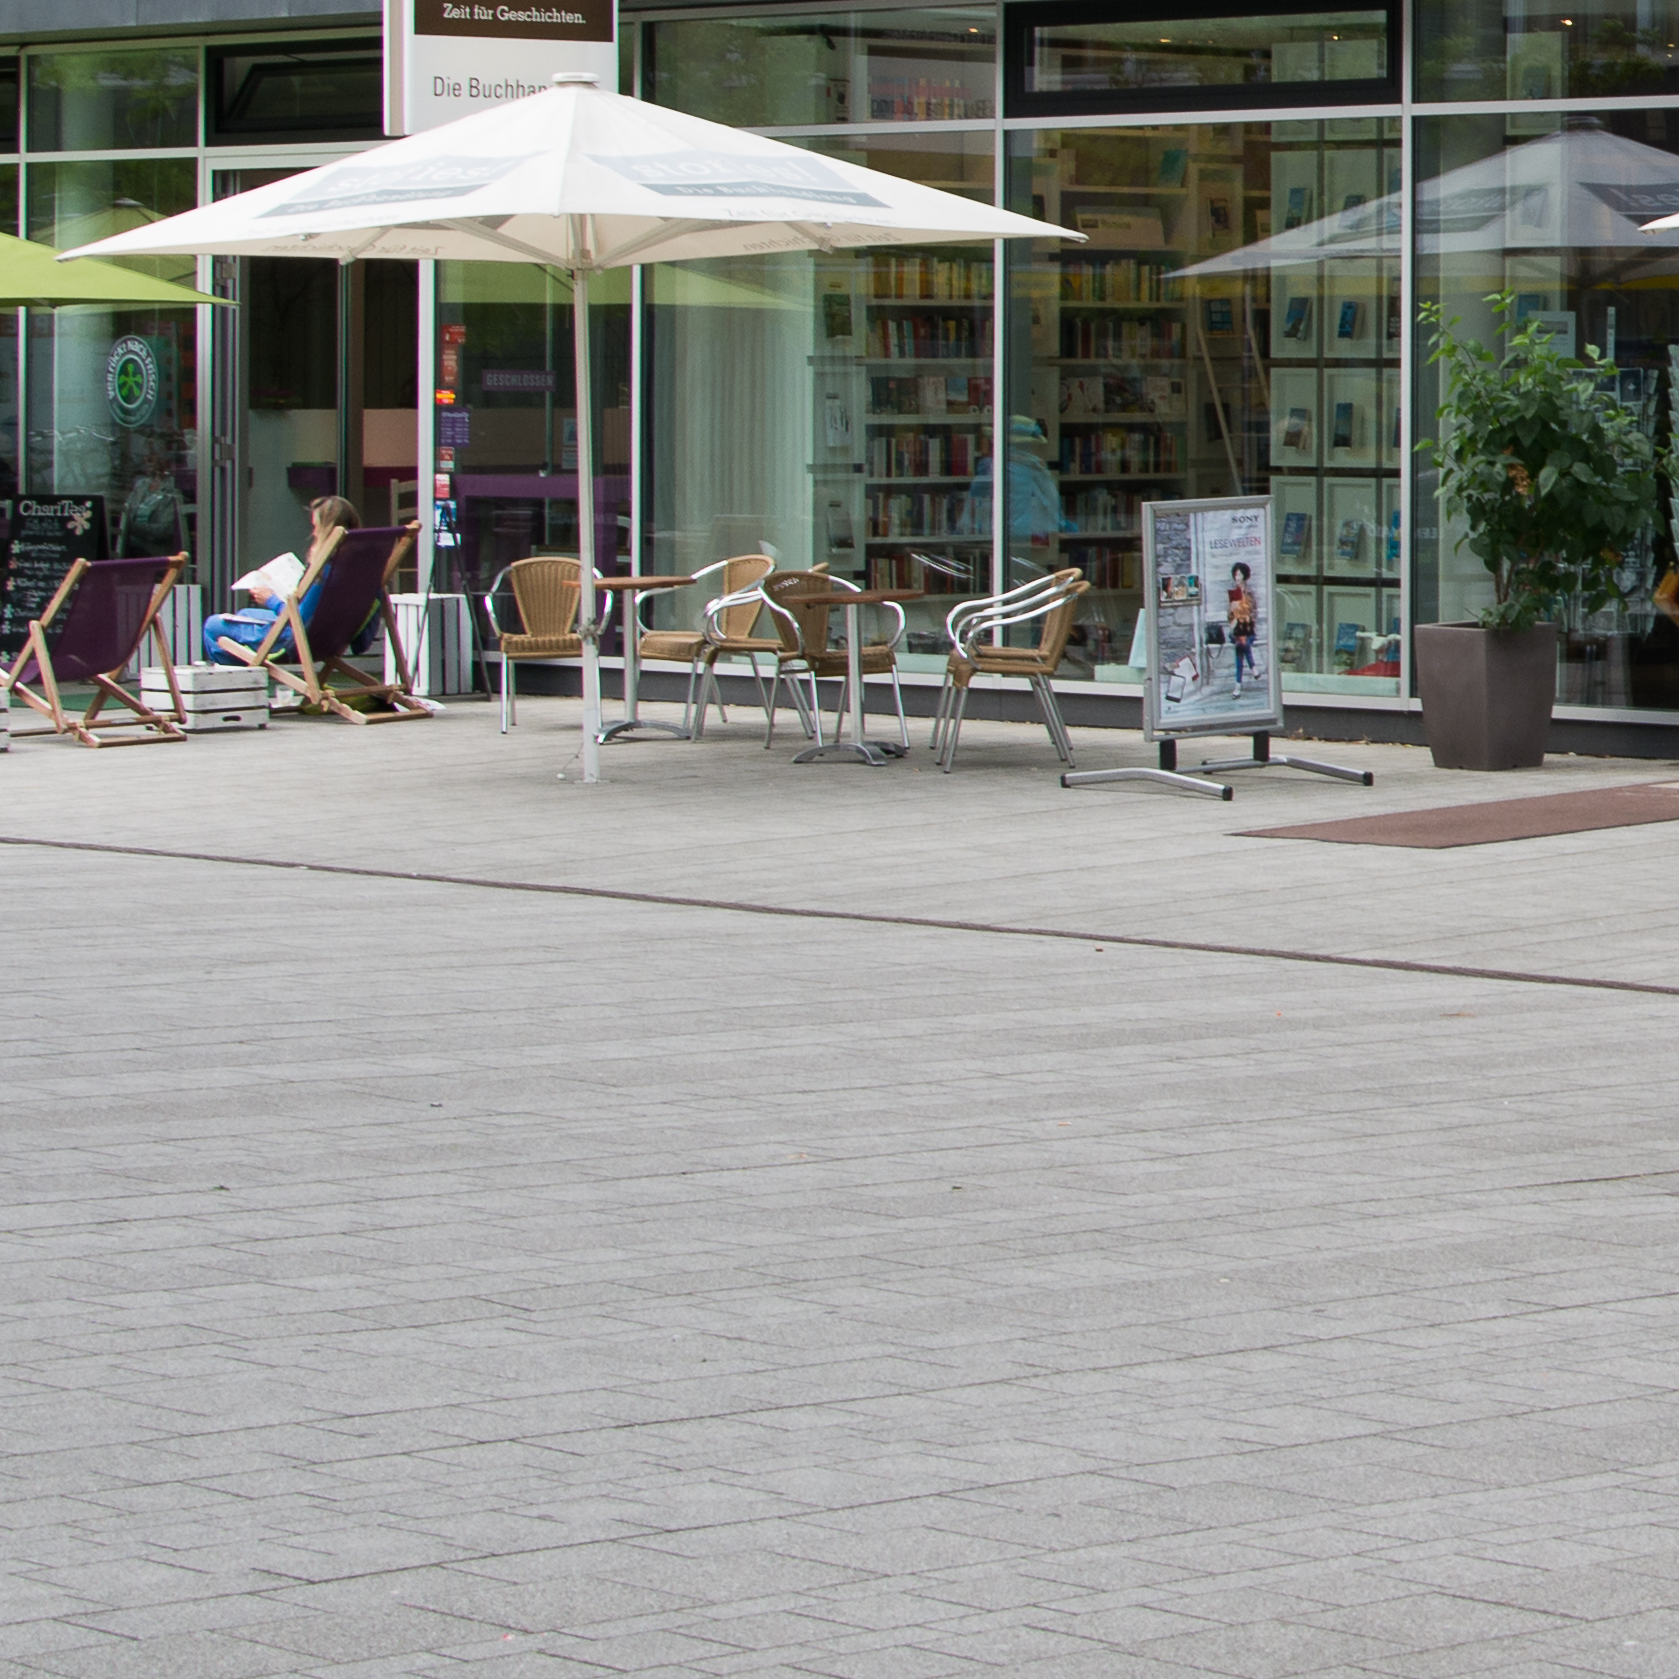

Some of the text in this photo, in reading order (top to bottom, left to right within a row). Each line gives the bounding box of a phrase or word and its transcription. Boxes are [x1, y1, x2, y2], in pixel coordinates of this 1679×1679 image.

[443, 3, 586, 24] Zeit für Geschichten.
[433, 76, 548, 99] Die Buchhan
[486, 373, 554, 387] GESCHLOSSEN
[1231, 515, 1260, 524] SONY
[1209, 536, 1262, 550] LESEWELTEN
